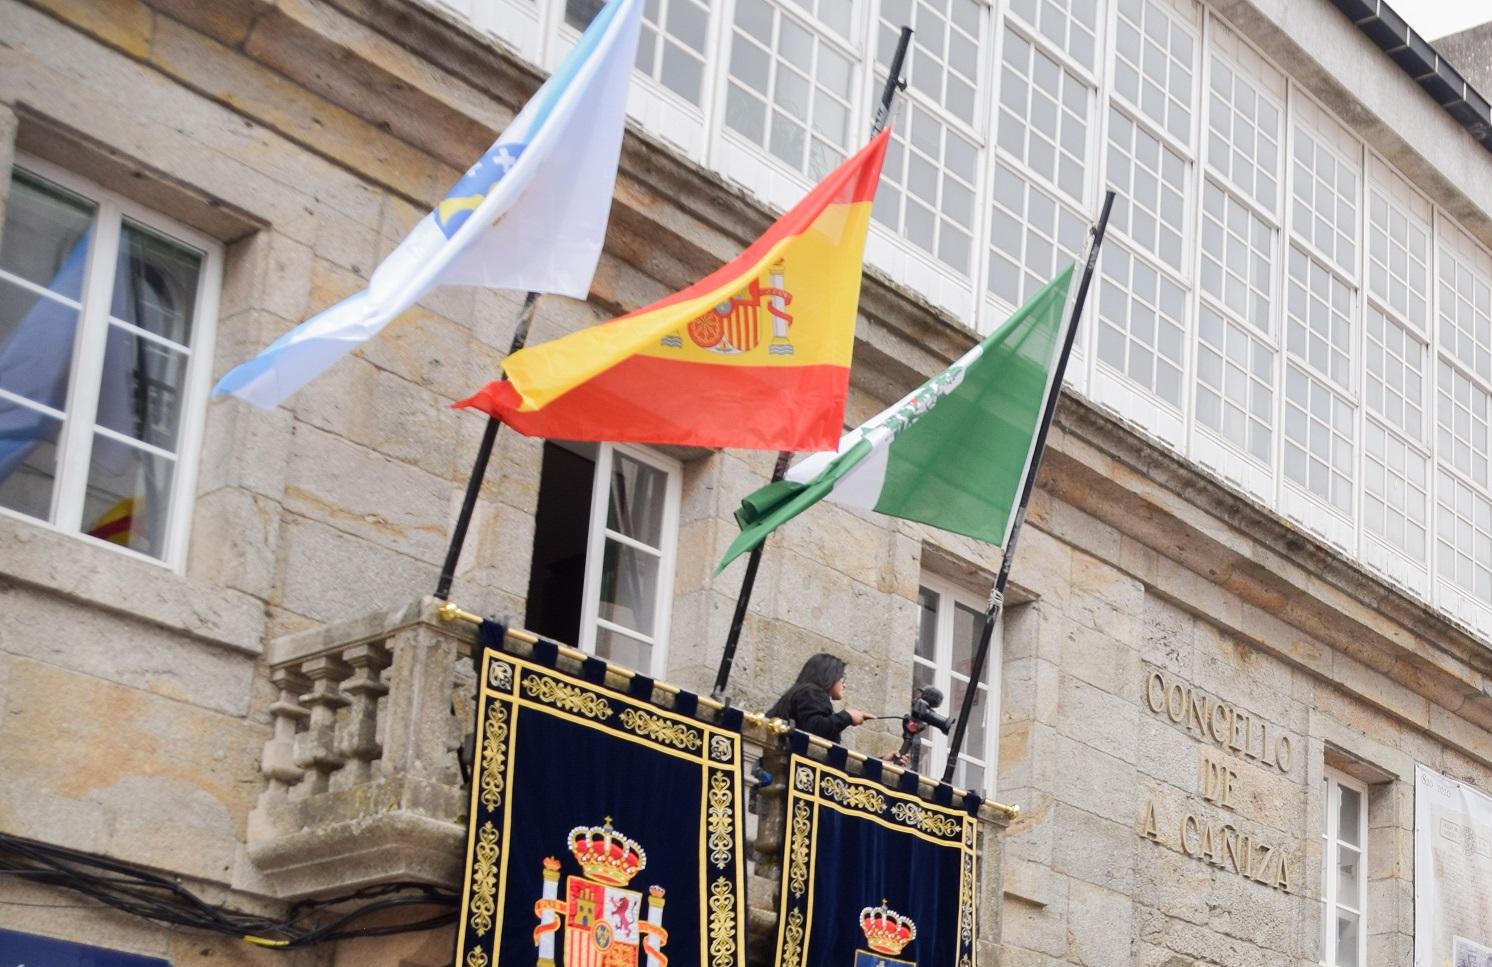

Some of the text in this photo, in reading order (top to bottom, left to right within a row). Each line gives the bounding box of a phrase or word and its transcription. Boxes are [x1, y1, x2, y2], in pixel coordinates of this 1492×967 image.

[1146, 671, 1292, 773] CONCELLO
[1203, 758, 1238, 810] DE
[1138, 800, 1291, 894] A CAÑIZA
